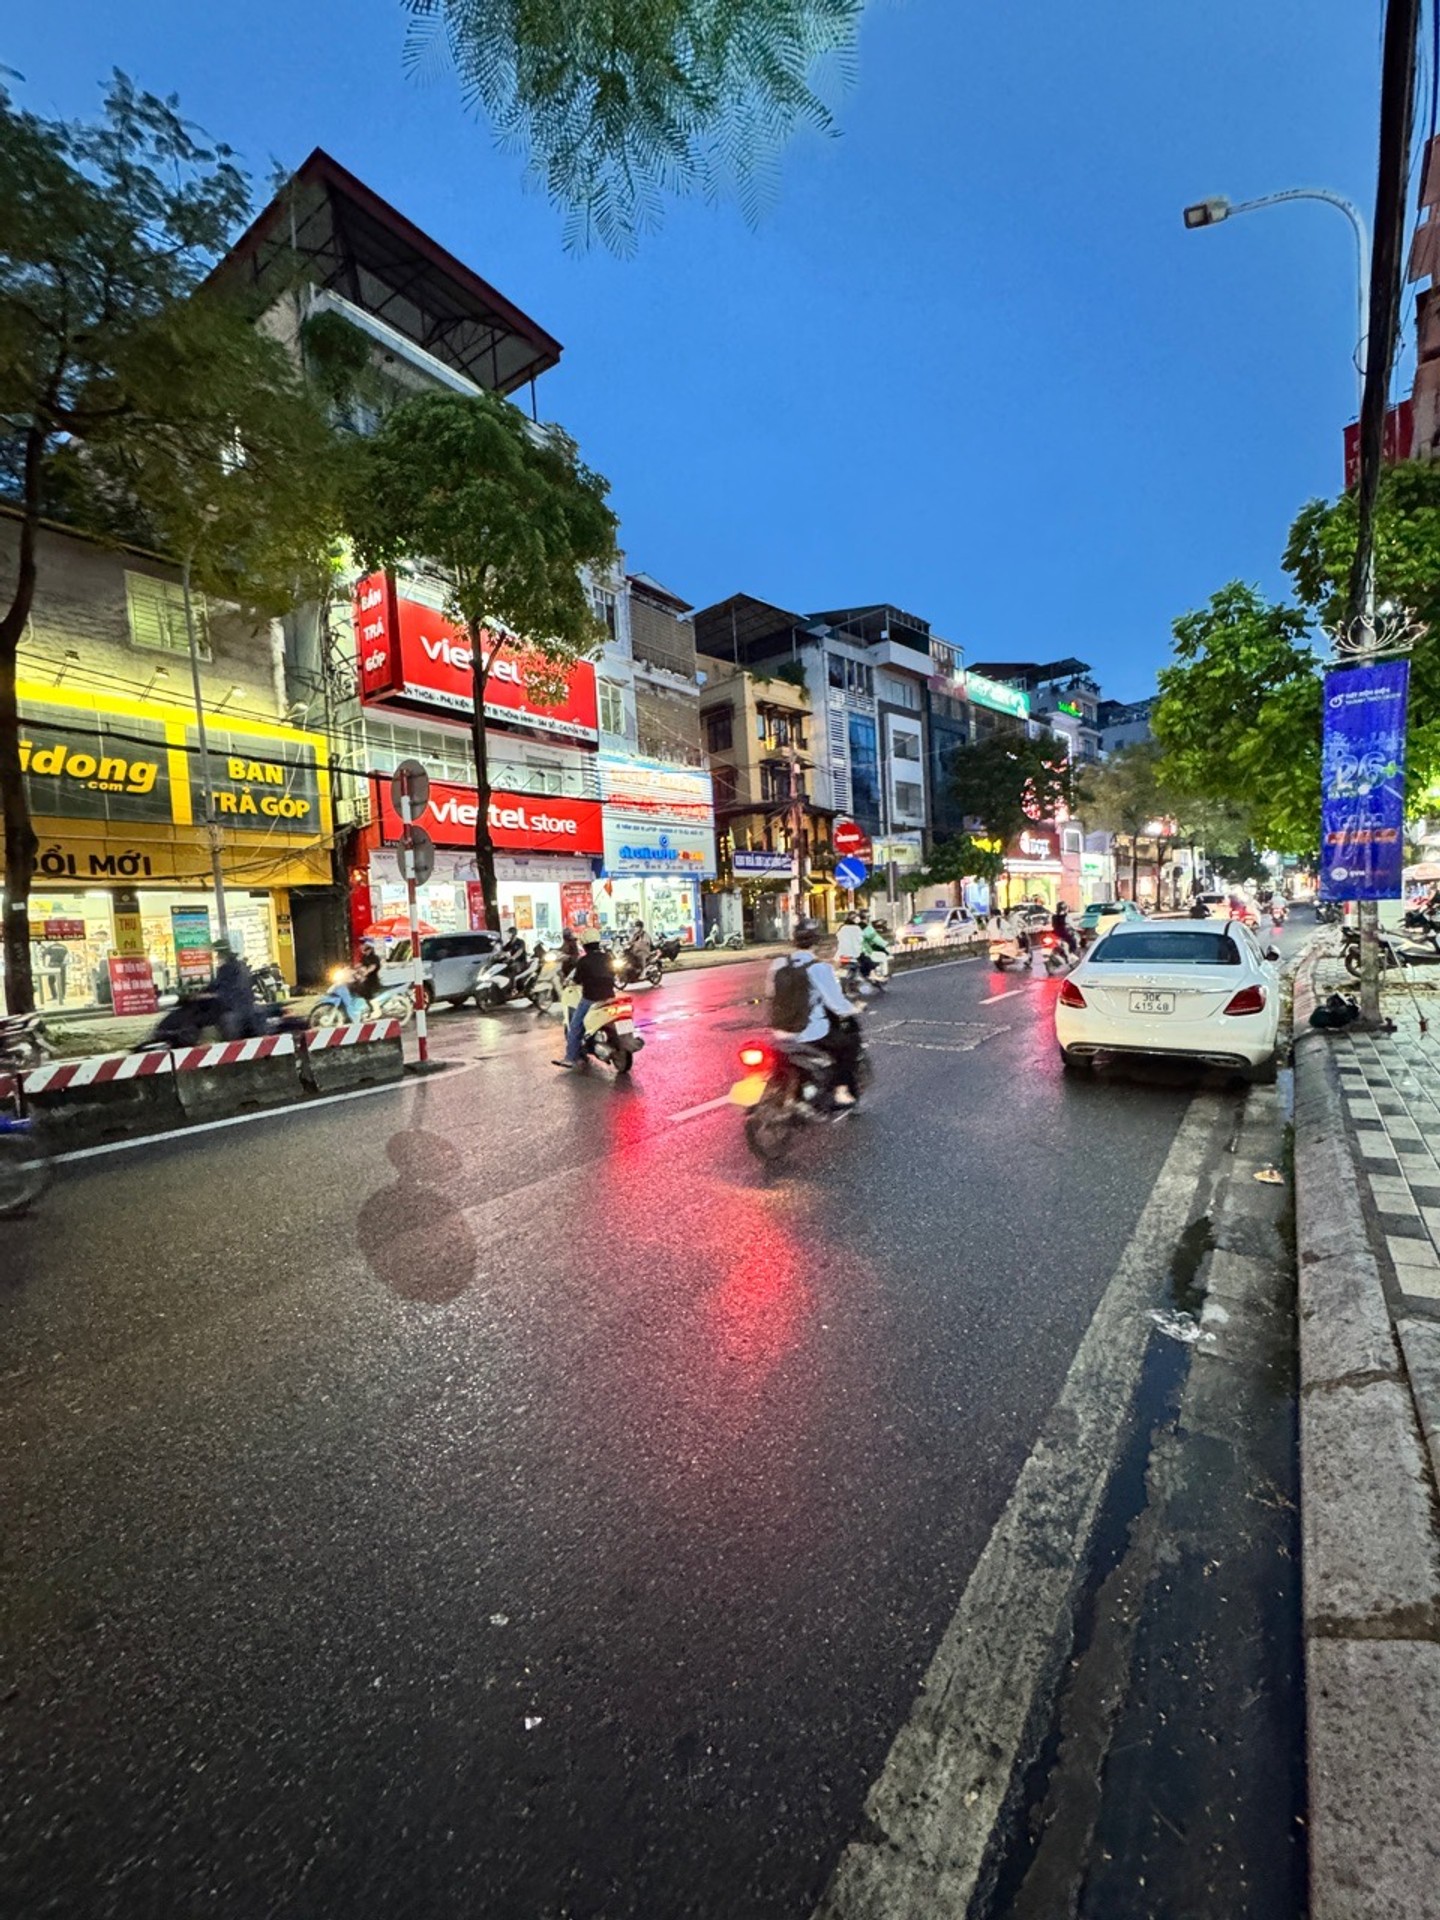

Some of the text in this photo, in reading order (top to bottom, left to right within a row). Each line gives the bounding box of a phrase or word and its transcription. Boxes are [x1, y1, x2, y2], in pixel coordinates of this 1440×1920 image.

[361, 588, 382, 612] BÁN
[363, 616, 384, 641] TRẢ
[365, 650, 386, 672] GÓP
[420, 635, 523, 684] vietel
[79, 780, 123, 792] .com
[260, 793, 310, 819] GÓP
[428, 798, 577, 834] vietel store
[89, 850, 152, 876] MỚI
